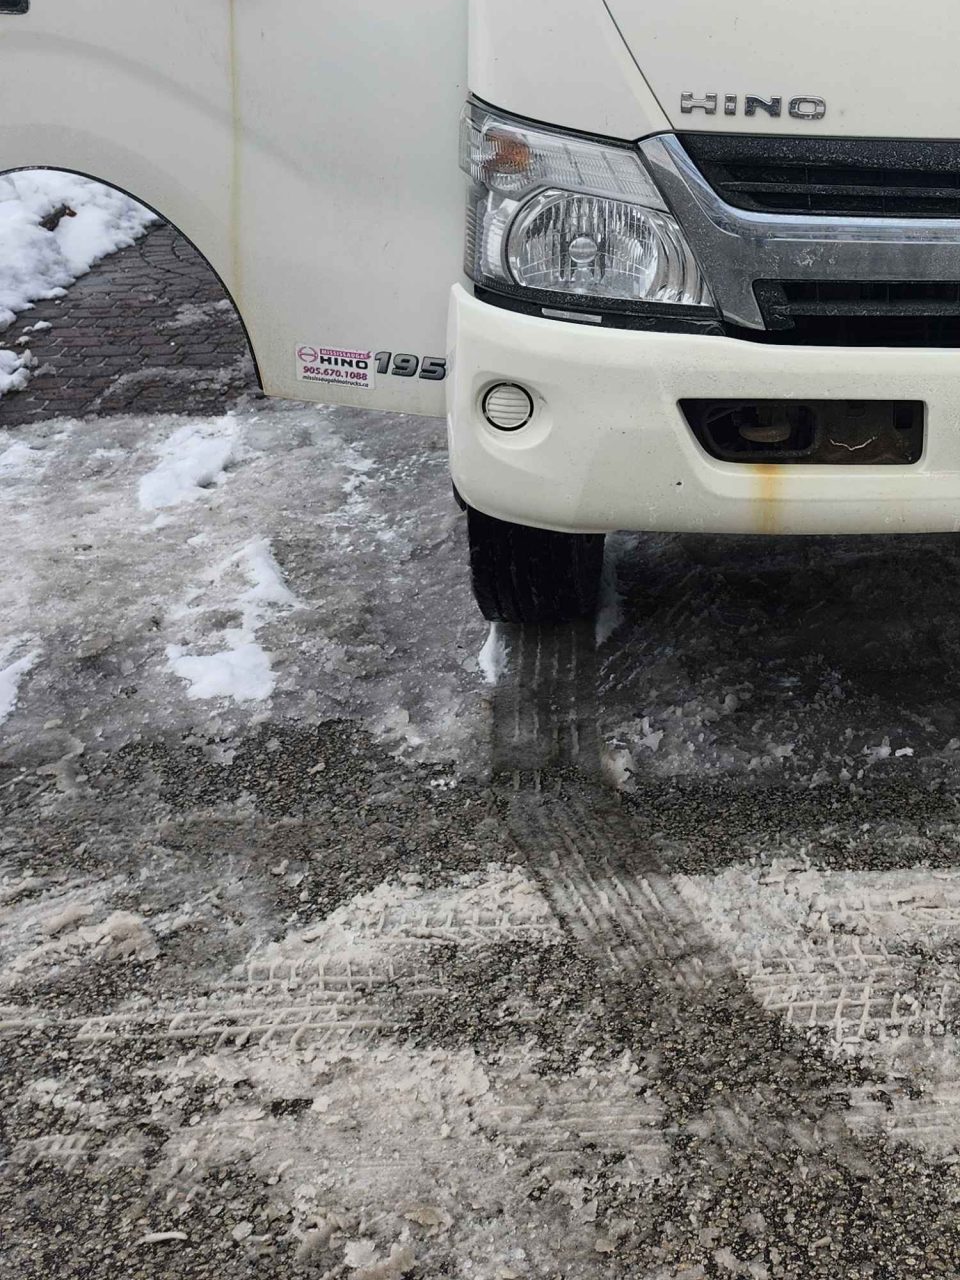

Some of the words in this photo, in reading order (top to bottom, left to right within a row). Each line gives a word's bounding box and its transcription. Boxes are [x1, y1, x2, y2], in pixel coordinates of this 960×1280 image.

[681, 92, 827, 120] HINO
[321, 349, 366, 359] MISSISSAUGA
[320, 356, 368, 369] HINO
[374, 351, 447, 381] 195
[303, 366, 368, 380] 905.670.1088
